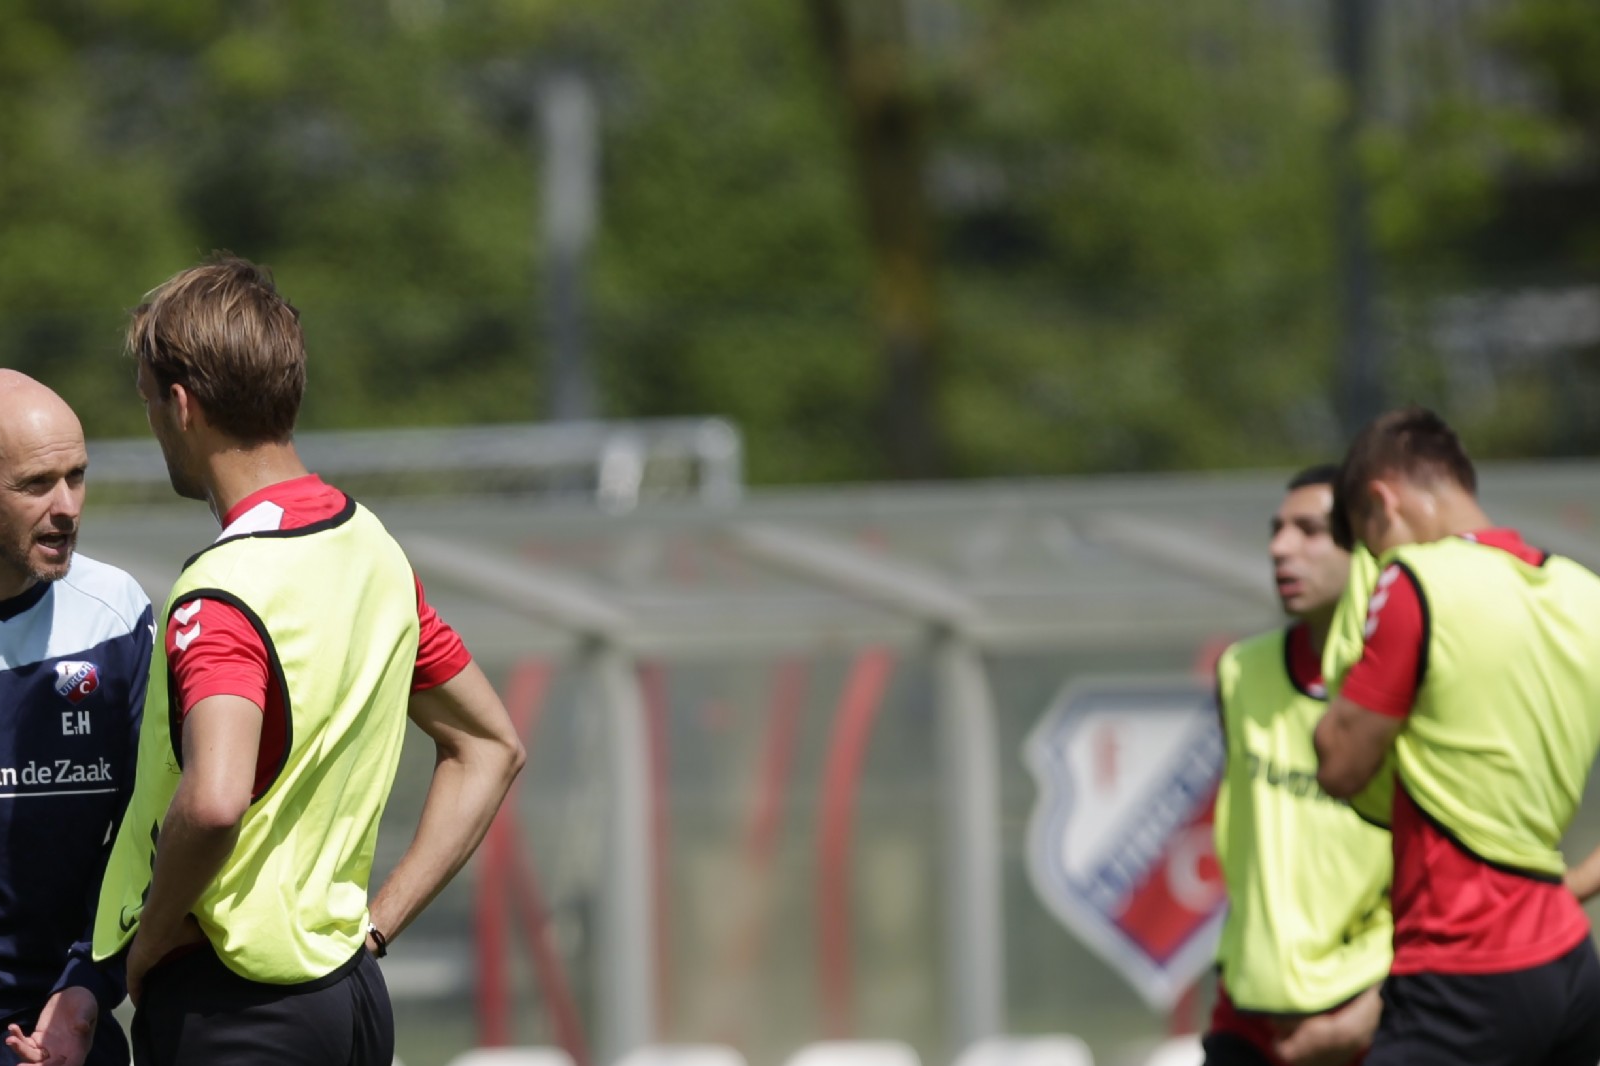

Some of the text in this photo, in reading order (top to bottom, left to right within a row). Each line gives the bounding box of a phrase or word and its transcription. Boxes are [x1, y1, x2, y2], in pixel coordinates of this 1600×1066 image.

[79, 680, 91, 694] C
[21, 755, 52, 785] de
[54, 757, 113, 785] Zaak
